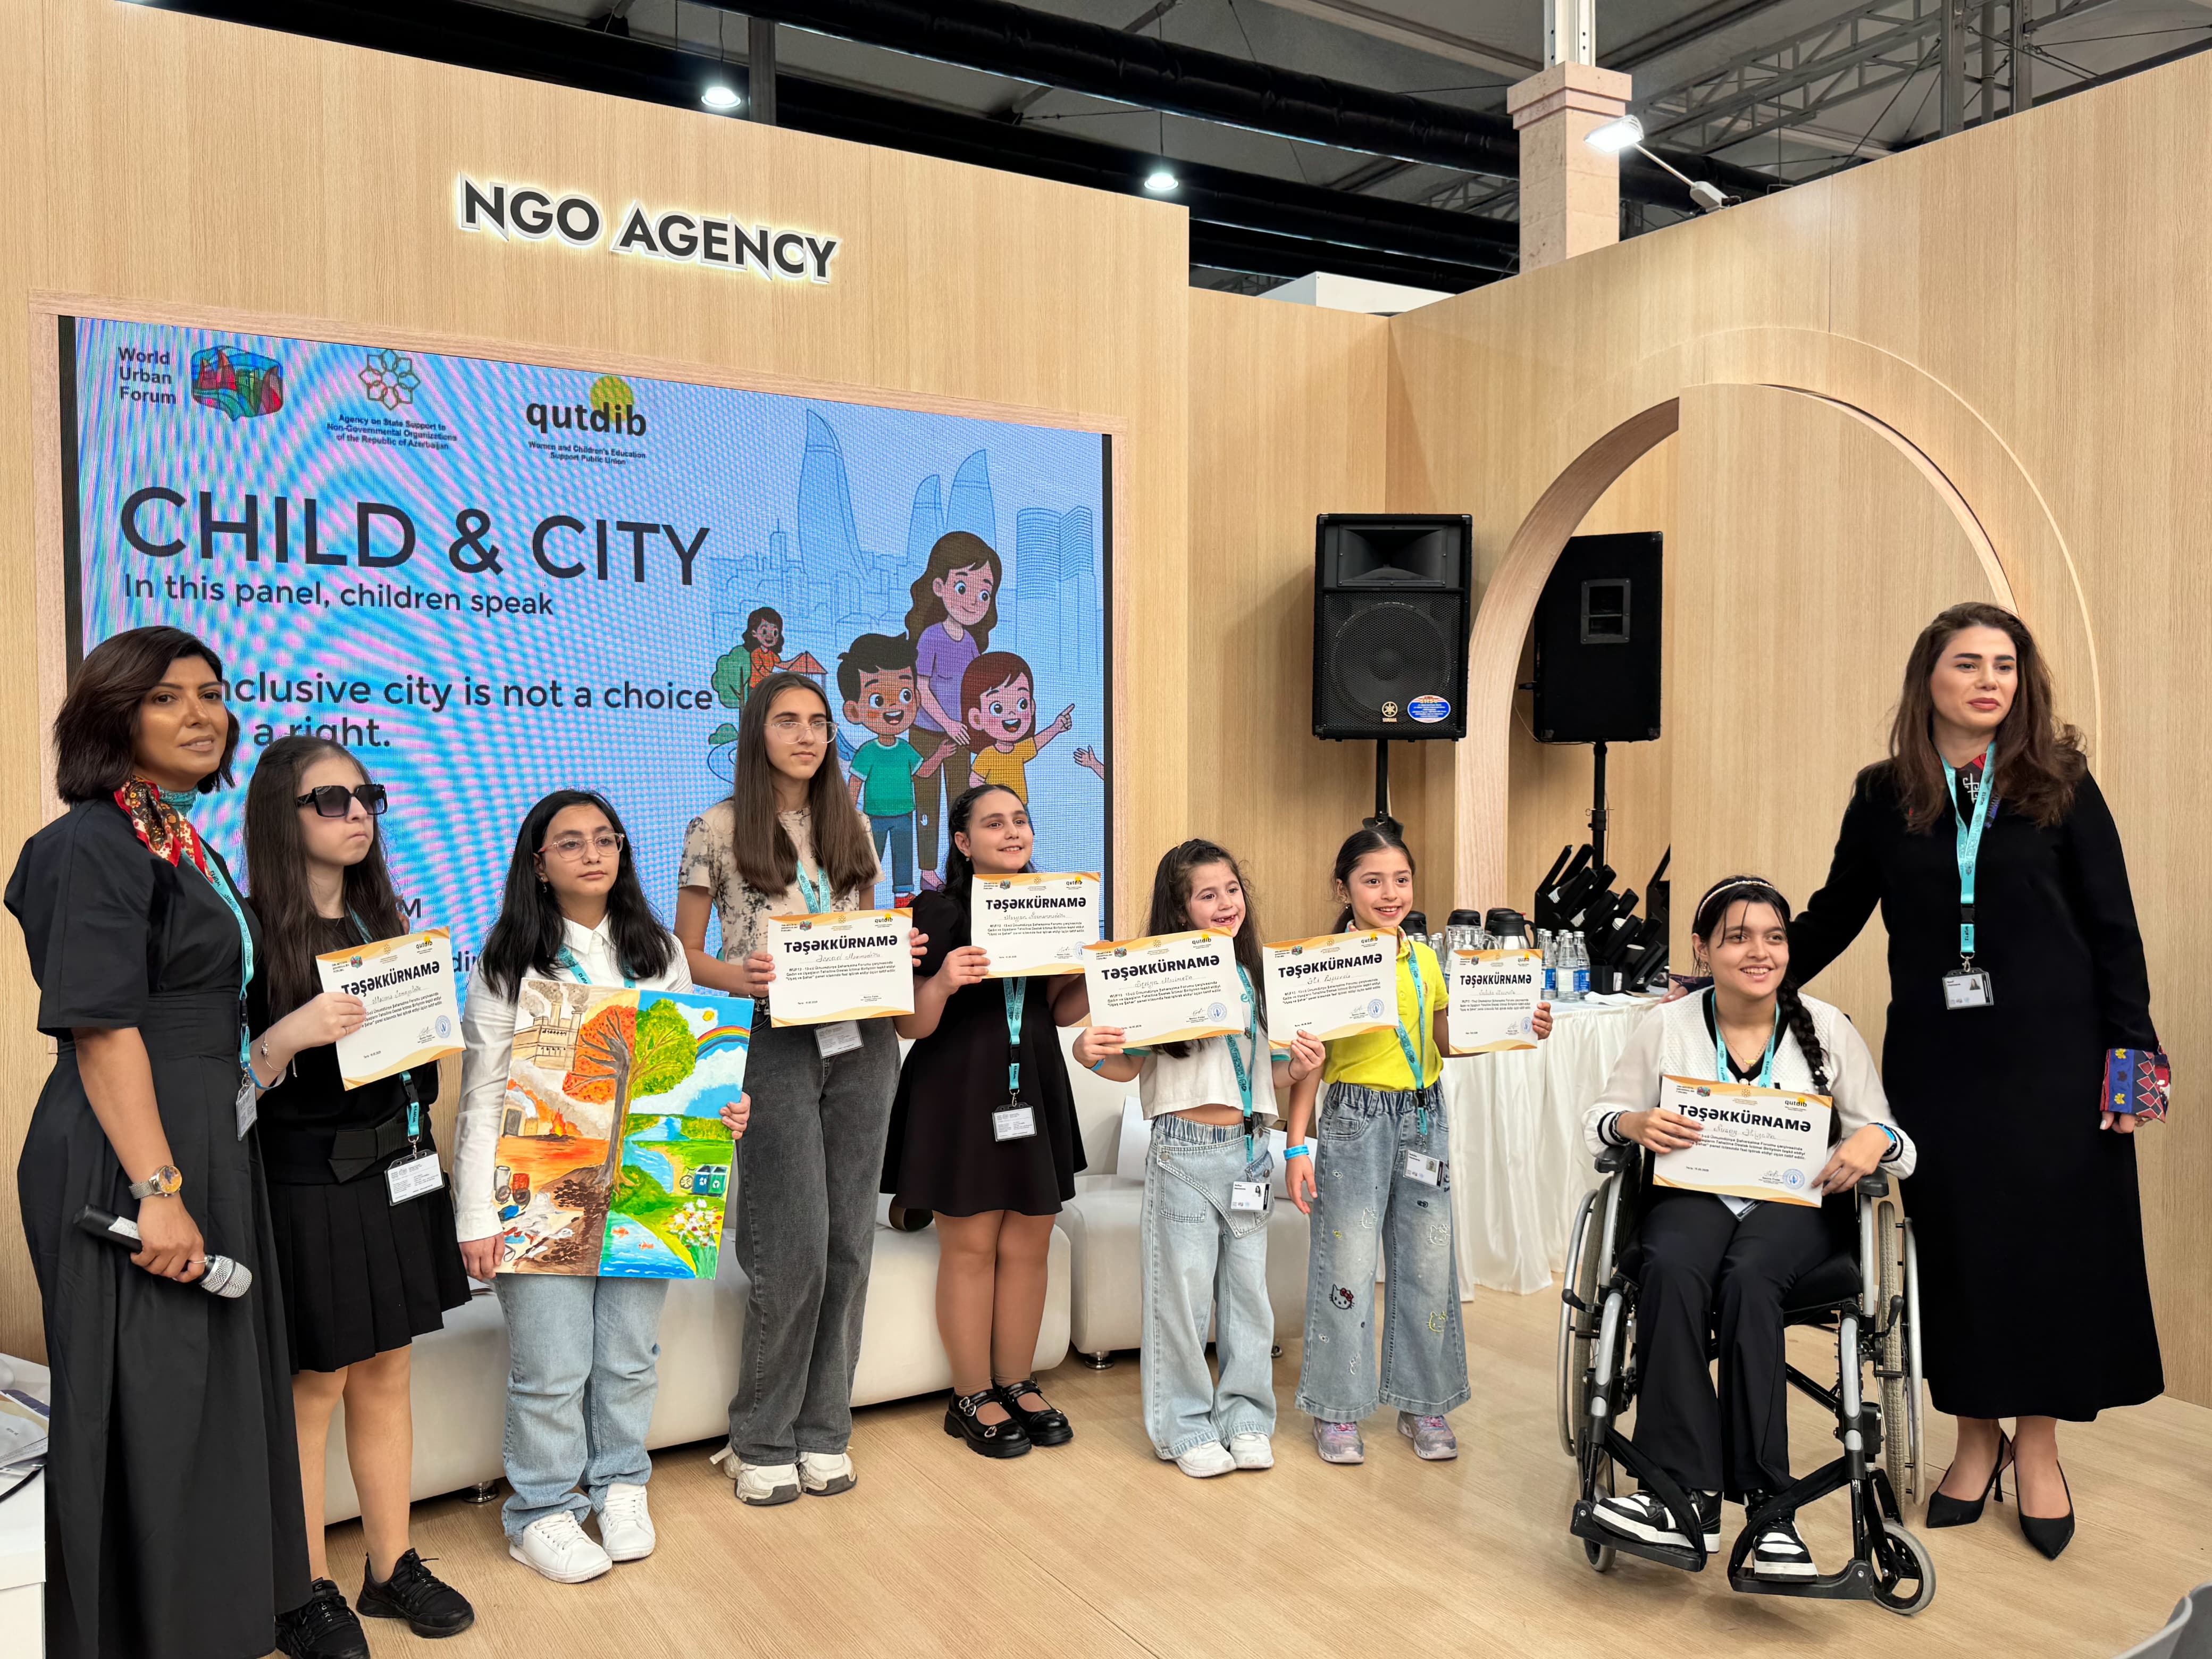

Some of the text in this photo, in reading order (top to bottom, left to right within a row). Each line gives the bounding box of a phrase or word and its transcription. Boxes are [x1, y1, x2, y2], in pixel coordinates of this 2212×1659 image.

[465, 180, 836, 277] NGO AGENCY
[118, 347, 170, 365] World
[120, 366, 172, 385] Urban
[120, 386, 177, 405] Forum
[339, 415, 368, 425] Agency
[383, 418, 403, 427] State
[405, 421, 435, 430] Support
[526, 402, 646, 436] qutdib
[326, 423, 401, 437] Non-Governmental
[346, 433, 358, 442] the
[362, 435, 397, 446] Republic
[408, 440, 449, 450] Azerbaijan
[528, 441, 556, 451] Women
[573, 445, 609, 455] Children's
[611, 448, 646, 459] Education
[551, 451, 626, 465] Support Public Union
[121, 487, 710, 586] CHILD & CITY
[125, 575, 553, 617] In this panel, children speak
[222, 671, 713, 713] nclusive city is not a choice
[254, 724, 274, 746] a
[986, 895, 1086, 912] TƏŞƏKKÜRNAMƏ
[784, 935, 898, 954] TƏŞƏKKÜRNAMƏ
[1102, 955, 1220, 981] TƏŞƏKKÜRNAMƏ
[1278, 953, 1382, 978] TƏŞƏKKÜRNAMƏ
[341, 960, 440, 997] TƏŞƏKKÜRNAMƏ
[1460, 971, 1531, 988] TƏŞƏKKÜRNAMƏ
[1784, 1099, 1807, 1108] qutdib
[1678, 1104, 1811, 1133] TƏŞƏKKÜRNAMƏ
